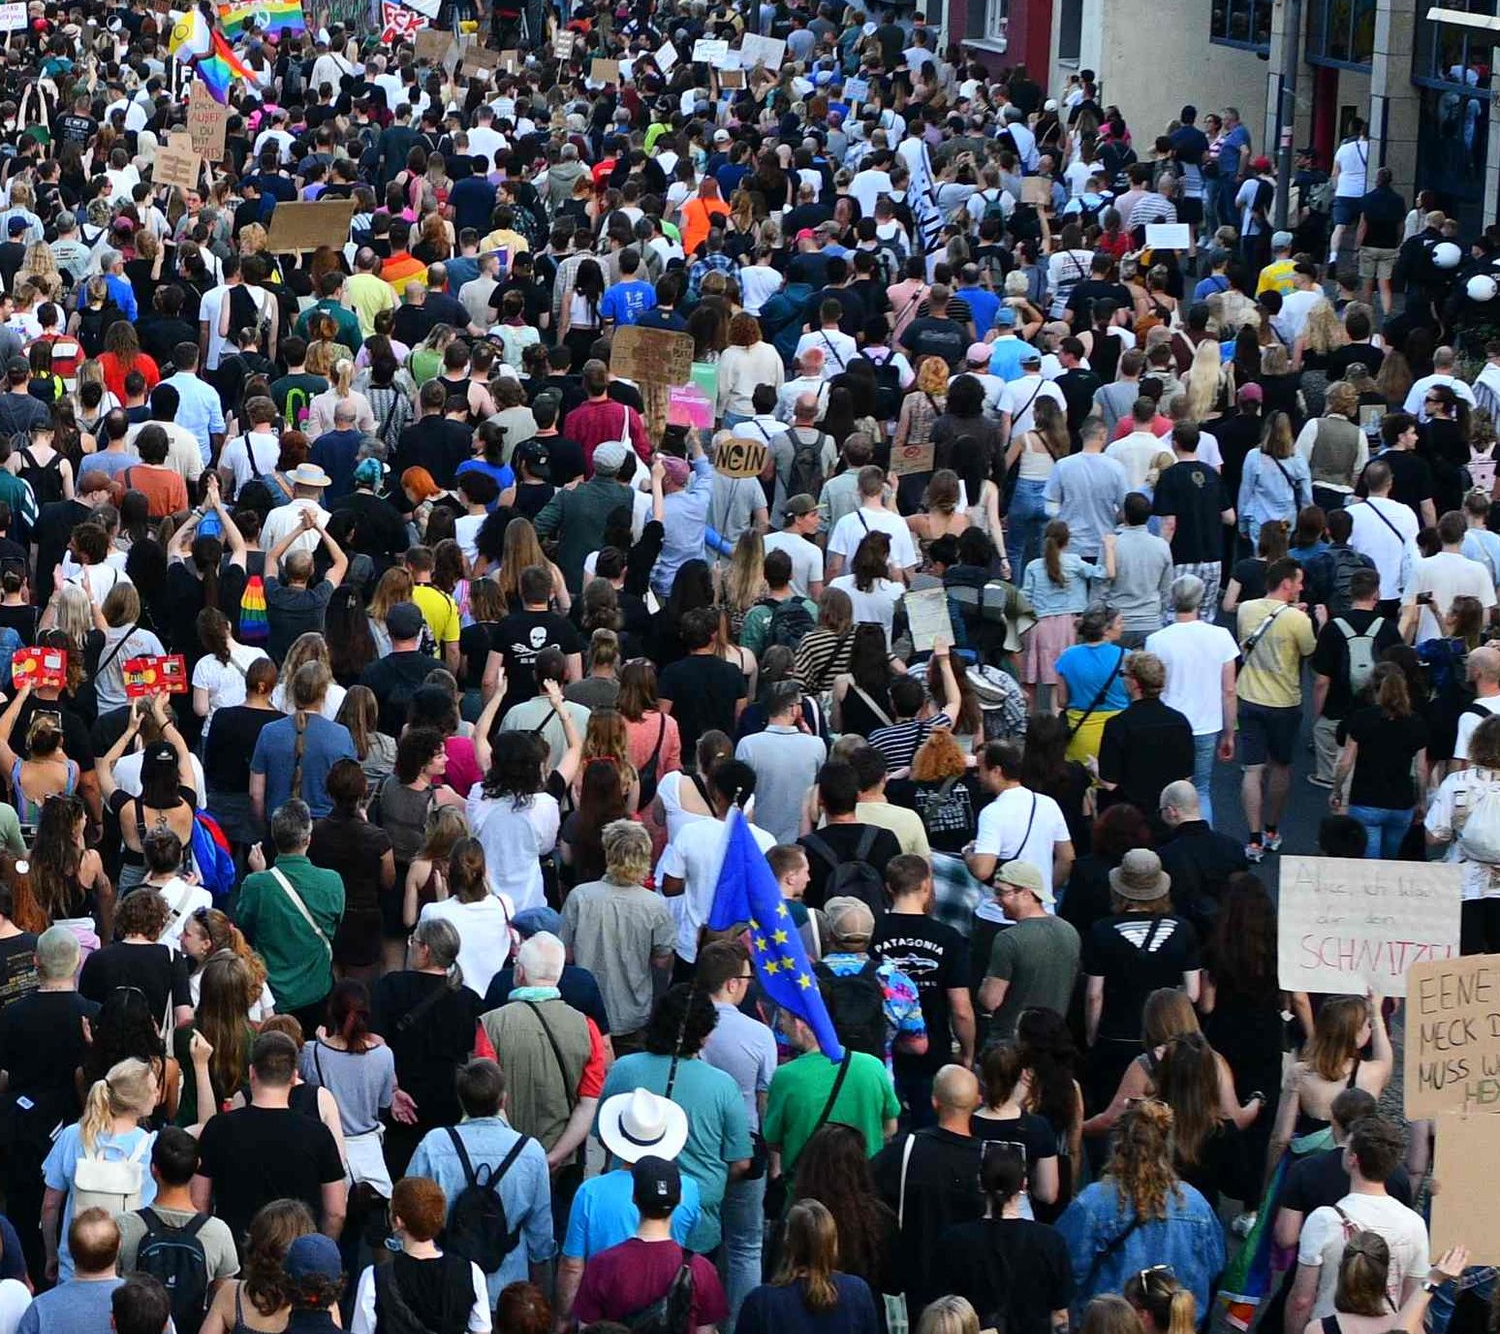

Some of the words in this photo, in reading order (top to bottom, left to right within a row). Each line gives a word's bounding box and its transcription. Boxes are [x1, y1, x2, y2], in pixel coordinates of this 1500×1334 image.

[874, 937, 944, 956] PATAGONIA
[1418, 974, 1493, 1017] EENE
[1418, 1058, 1470, 1094] MUSS
